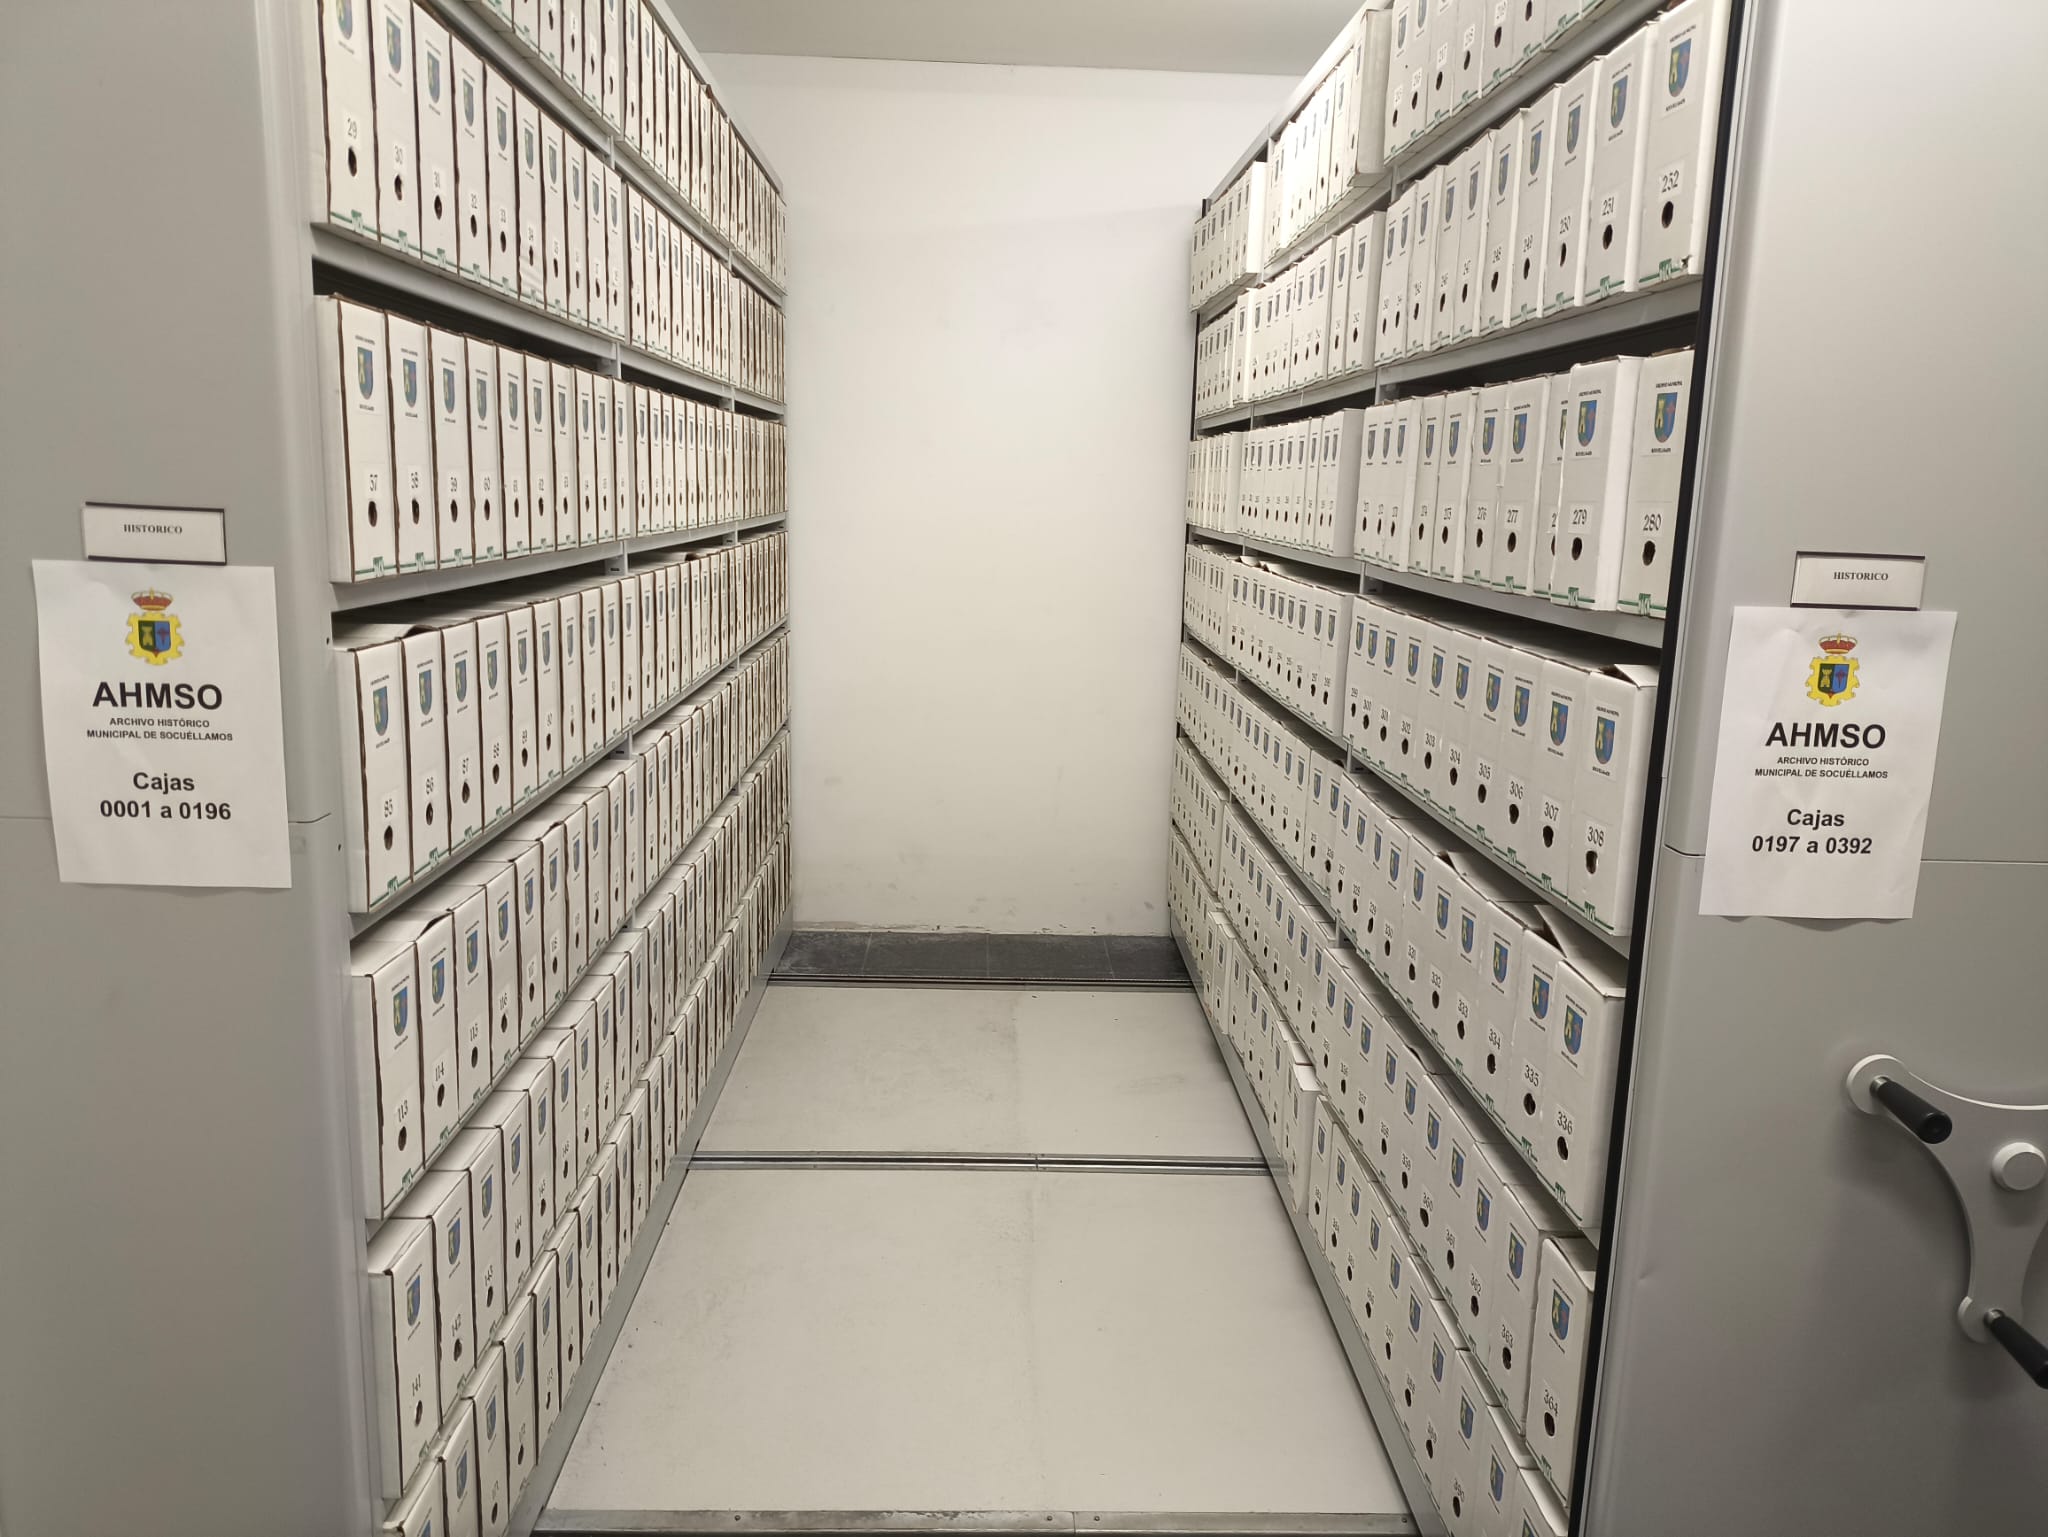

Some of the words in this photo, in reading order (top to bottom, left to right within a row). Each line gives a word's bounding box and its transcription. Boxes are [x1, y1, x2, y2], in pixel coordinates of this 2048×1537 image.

[1661, 169, 1680, 193] 252
[1602, 197, 1614, 216] 251
[1559, 215, 1571, 234] 250
[1477, 506, 1487, 520] 276
[1507, 509, 1519, 523] 277
[1572, 509, 1587, 525] 279
[1643, 513, 1662, 531] 280
[123, 523, 183, 535] HISTORICO
[1833, 571, 1889, 582] HISTORICO
[92, 681, 223, 711] AHMSO
[109, 717, 155, 727] ARCHIVO
[157, 716, 210, 728] HISTÓRICO
[1401, 720, 1411, 735] 302
[87, 730, 141, 740] MUNICIPAL
[143, 731, 157, 740] DE
[159, 730, 233, 742] SOCUÉLLAMOS
[1425, 733, 1436, 747] 303
[1765, 722, 1887, 750] AHMSO
[1450, 749, 1461, 765] 304
[1777, 757, 1818, 766] ARCHIVO
[1819, 755, 1870, 767] HISTÓRICO
[1479, 763, 1491, 780] 305
[1754, 768, 1802, 777] MUNICIPAL
[1804, 769, 1817, 778] DE
[132, 772, 195, 795] Cajas
[1510, 781, 1524, 800] 306
[99, 800, 152, 818] 0001
[160, 805, 172, 819] a
[179, 801, 232, 821] 0196
[1544, 802, 1559, 821] 307
[1786, 808, 1845, 830] Cajas
[1587, 826, 1604, 847] 308
[1751, 836, 1800, 853] 0197
[1806, 839, 1818, 853] a
[1825, 837, 1873, 855] 0392
[1431, 971, 1442, 988] 332
[1458, 999, 1469, 1018] 333
[469, 1024, 479, 1042] 115
[1489, 1028, 1501, 1050] 334
[435, 1063, 445, 1083] 114
[1524, 1064, 1539, 1087] 335
[398, 1099, 409, 1122] 113
[1557, 1111, 1573, 1135] 336
[1446, 1229, 1456, 1249] 361
[1471, 1273, 1482, 1296] 362
[452, 1314, 462, 1336] 142
[1502, 1324, 1513, 1348] 363
[412, 1374, 422, 1396] 141
[1544, 1389, 1558, 1417] 364
